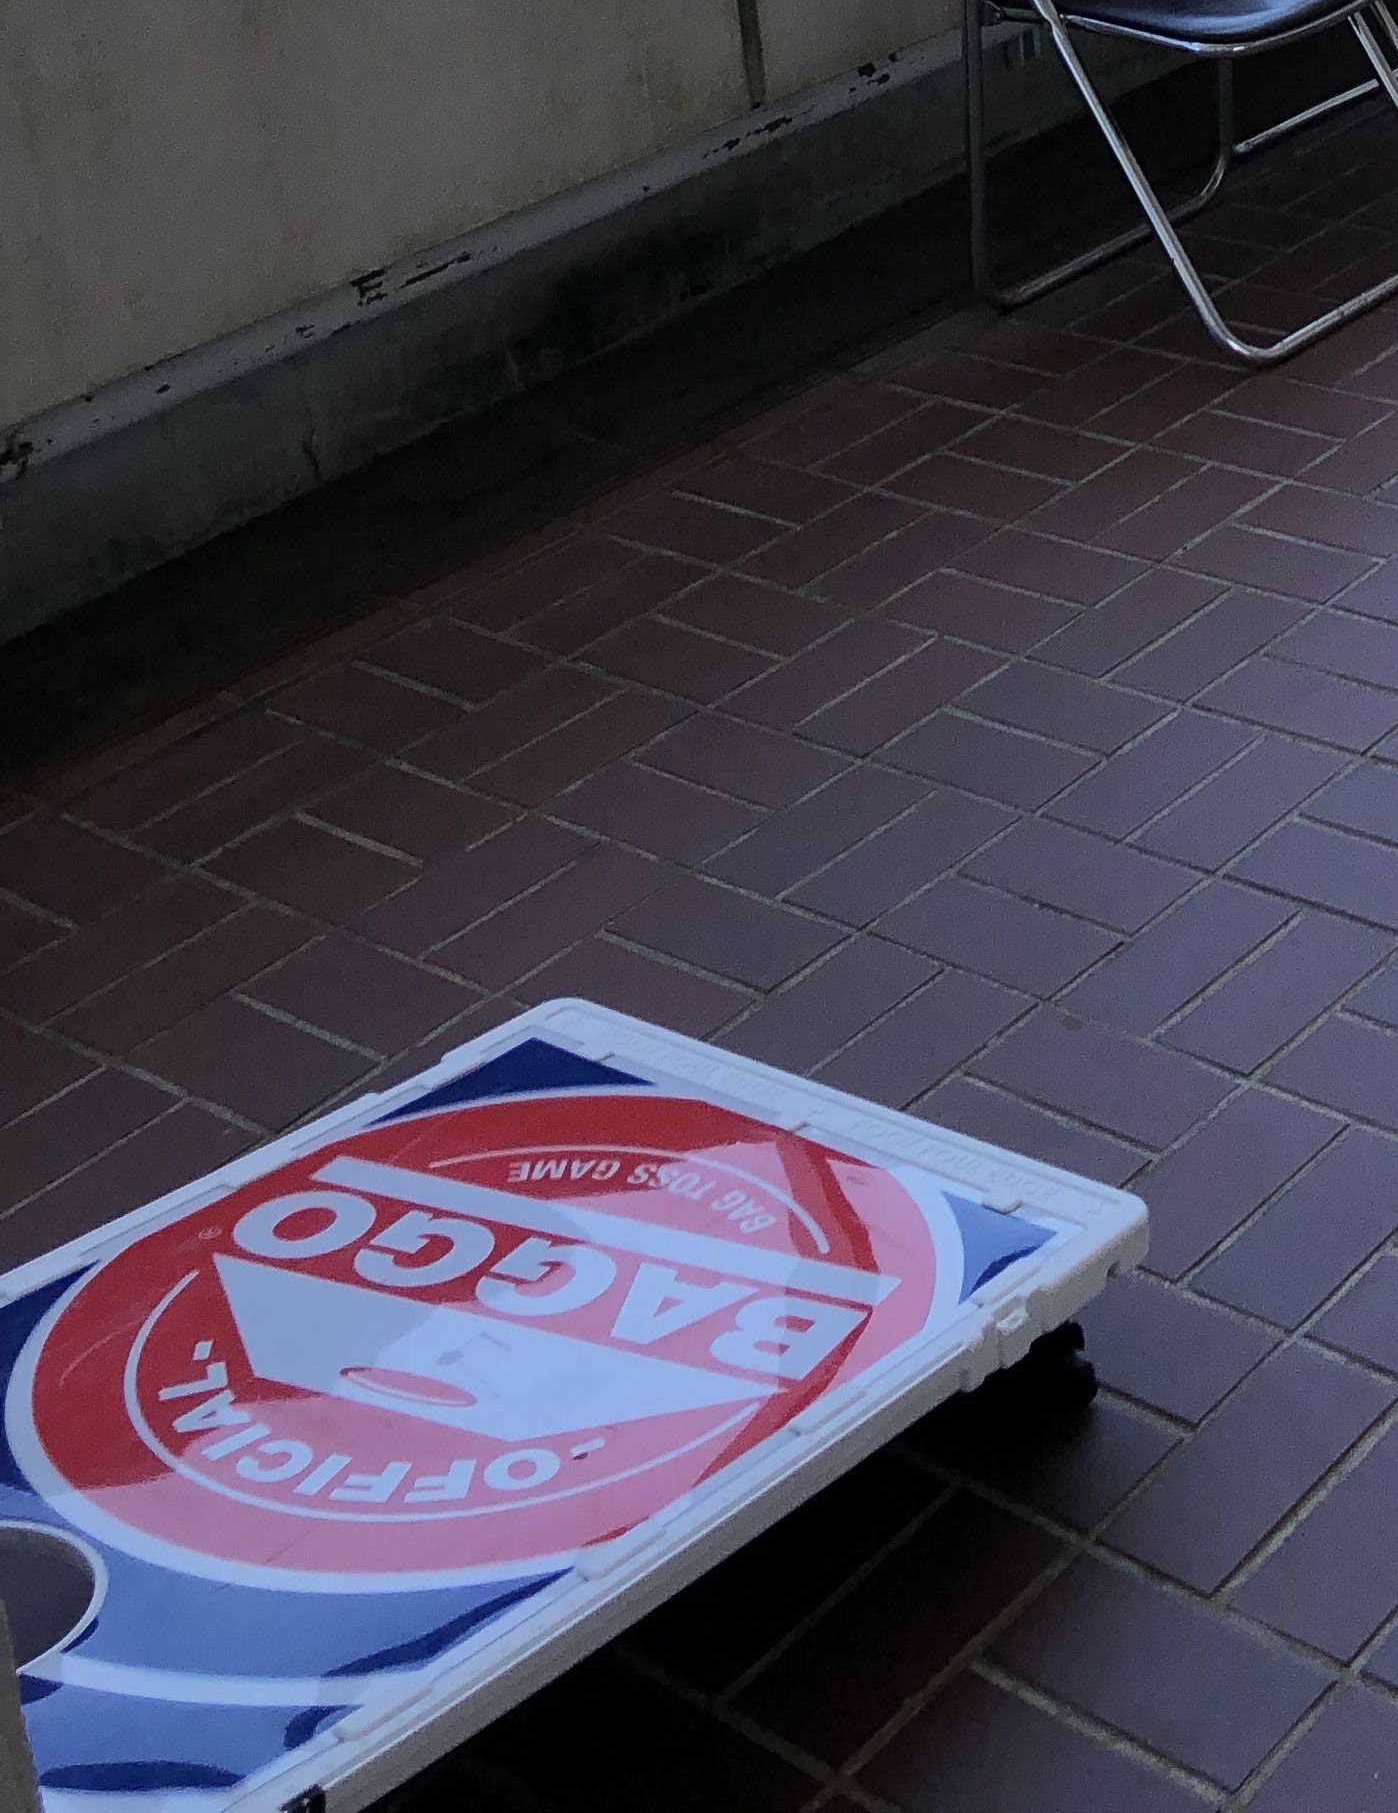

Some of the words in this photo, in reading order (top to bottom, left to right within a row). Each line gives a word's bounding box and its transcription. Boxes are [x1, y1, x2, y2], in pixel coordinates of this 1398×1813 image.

[507, 1159, 621, 1183] GAME
[627, 1163, 717, 1201] TOSS
[709, 1190, 777, 1234] BAG
[233, 1190, 874, 1382] BAGGO
[159, 1360, 561, 1505] OFFICIAL
